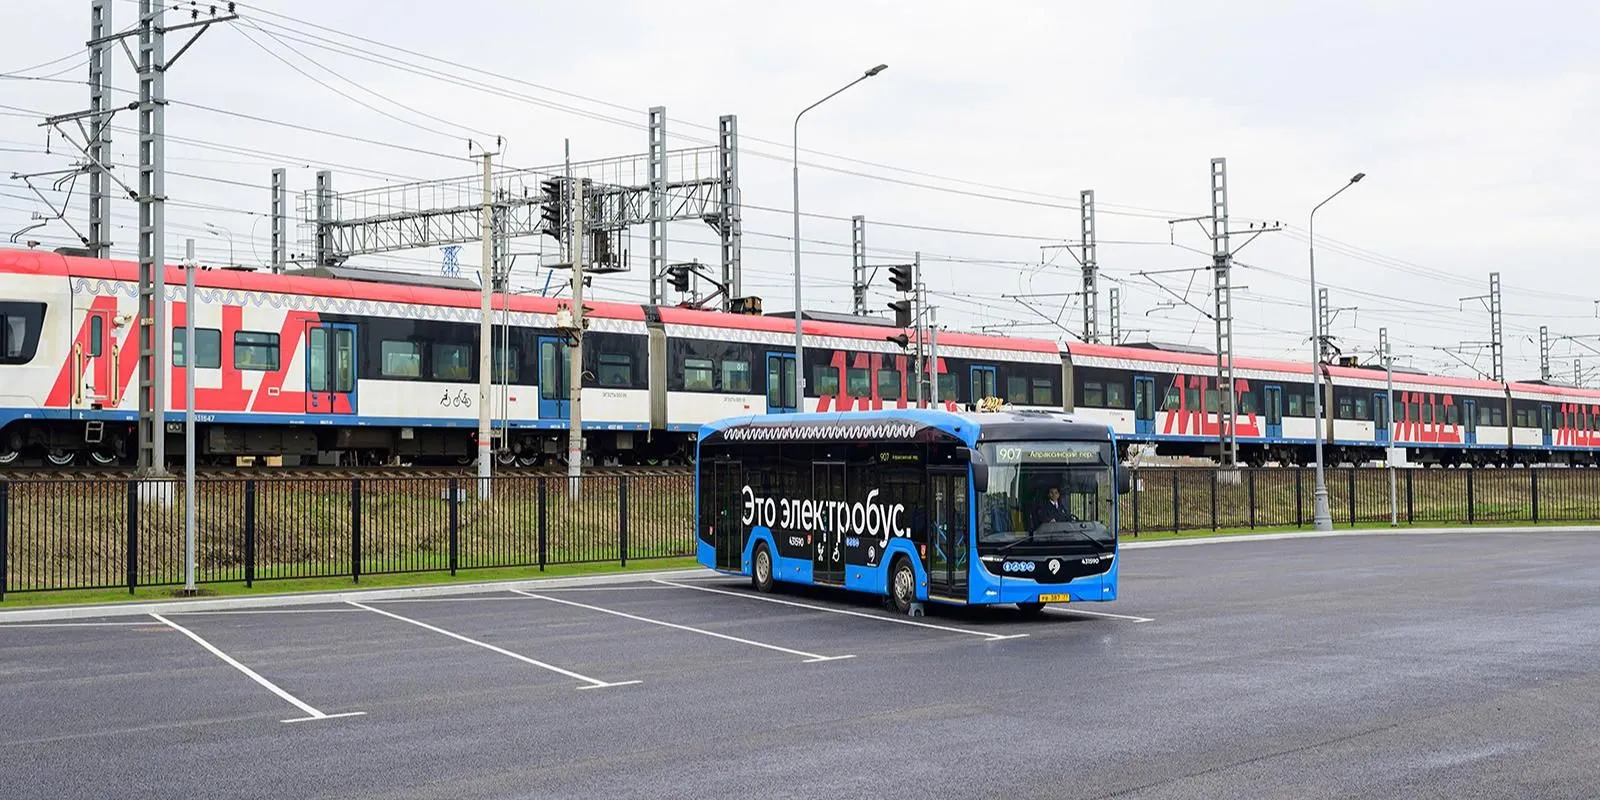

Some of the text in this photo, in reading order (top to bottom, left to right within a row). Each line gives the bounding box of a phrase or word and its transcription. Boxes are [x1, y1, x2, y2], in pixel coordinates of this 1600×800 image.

[999, 448, 1022, 461] 907
[742, 485, 911, 548] Это электробус.
